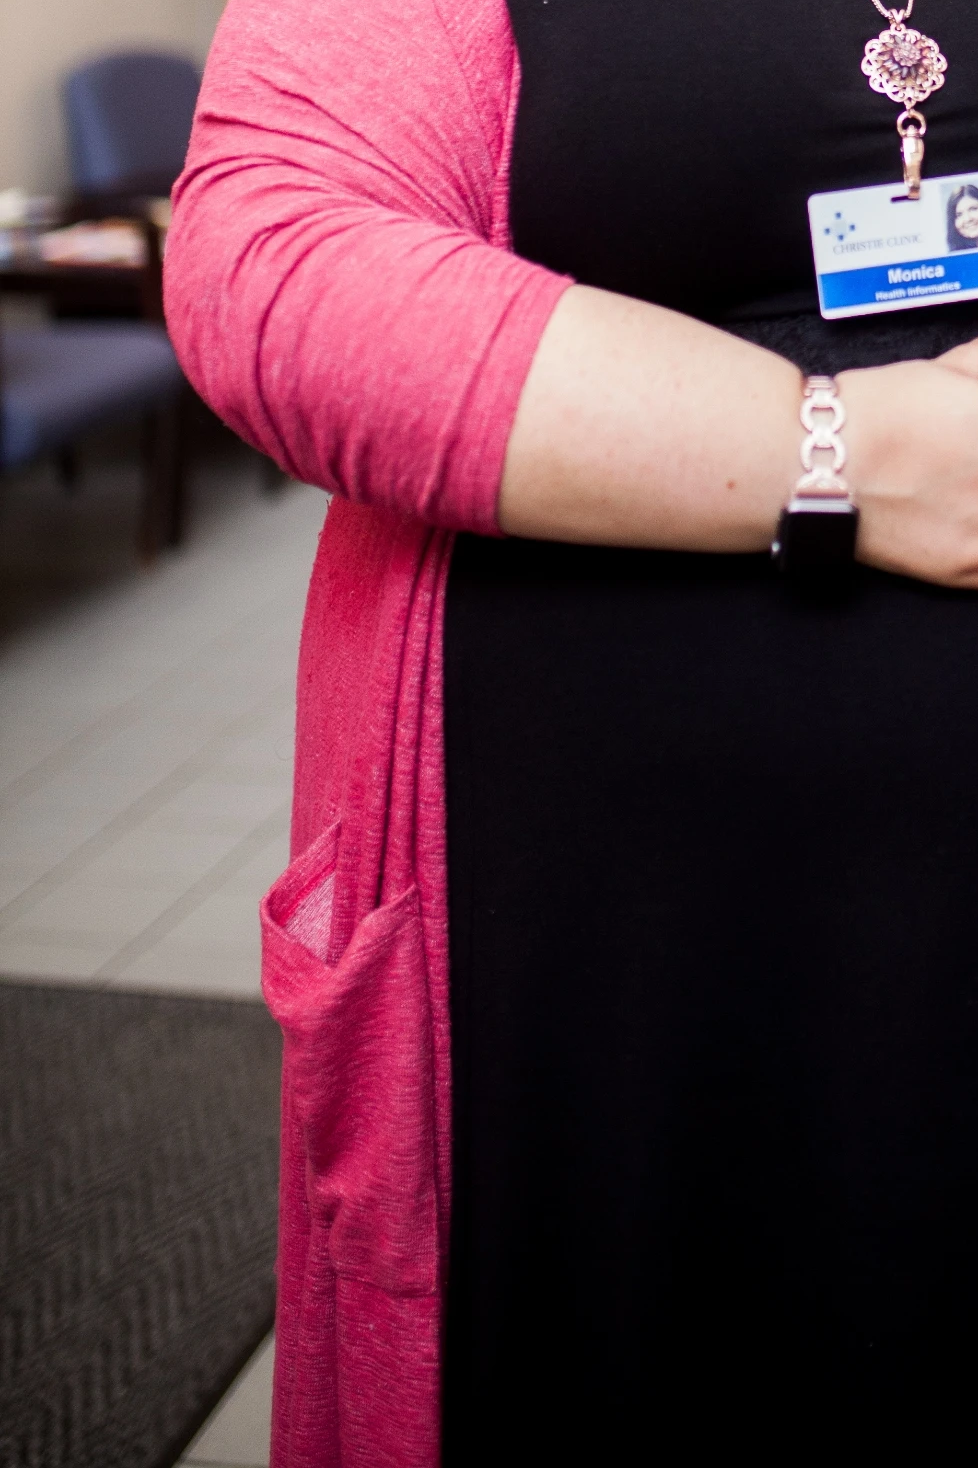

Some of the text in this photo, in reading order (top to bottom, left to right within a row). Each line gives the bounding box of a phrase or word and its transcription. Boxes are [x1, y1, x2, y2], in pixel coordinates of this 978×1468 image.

[832, 234, 924, 255] CHRISTIE CLINIC
[888, 264, 945, 284] Monica
[875, 281, 961, 302] Health Informatics
